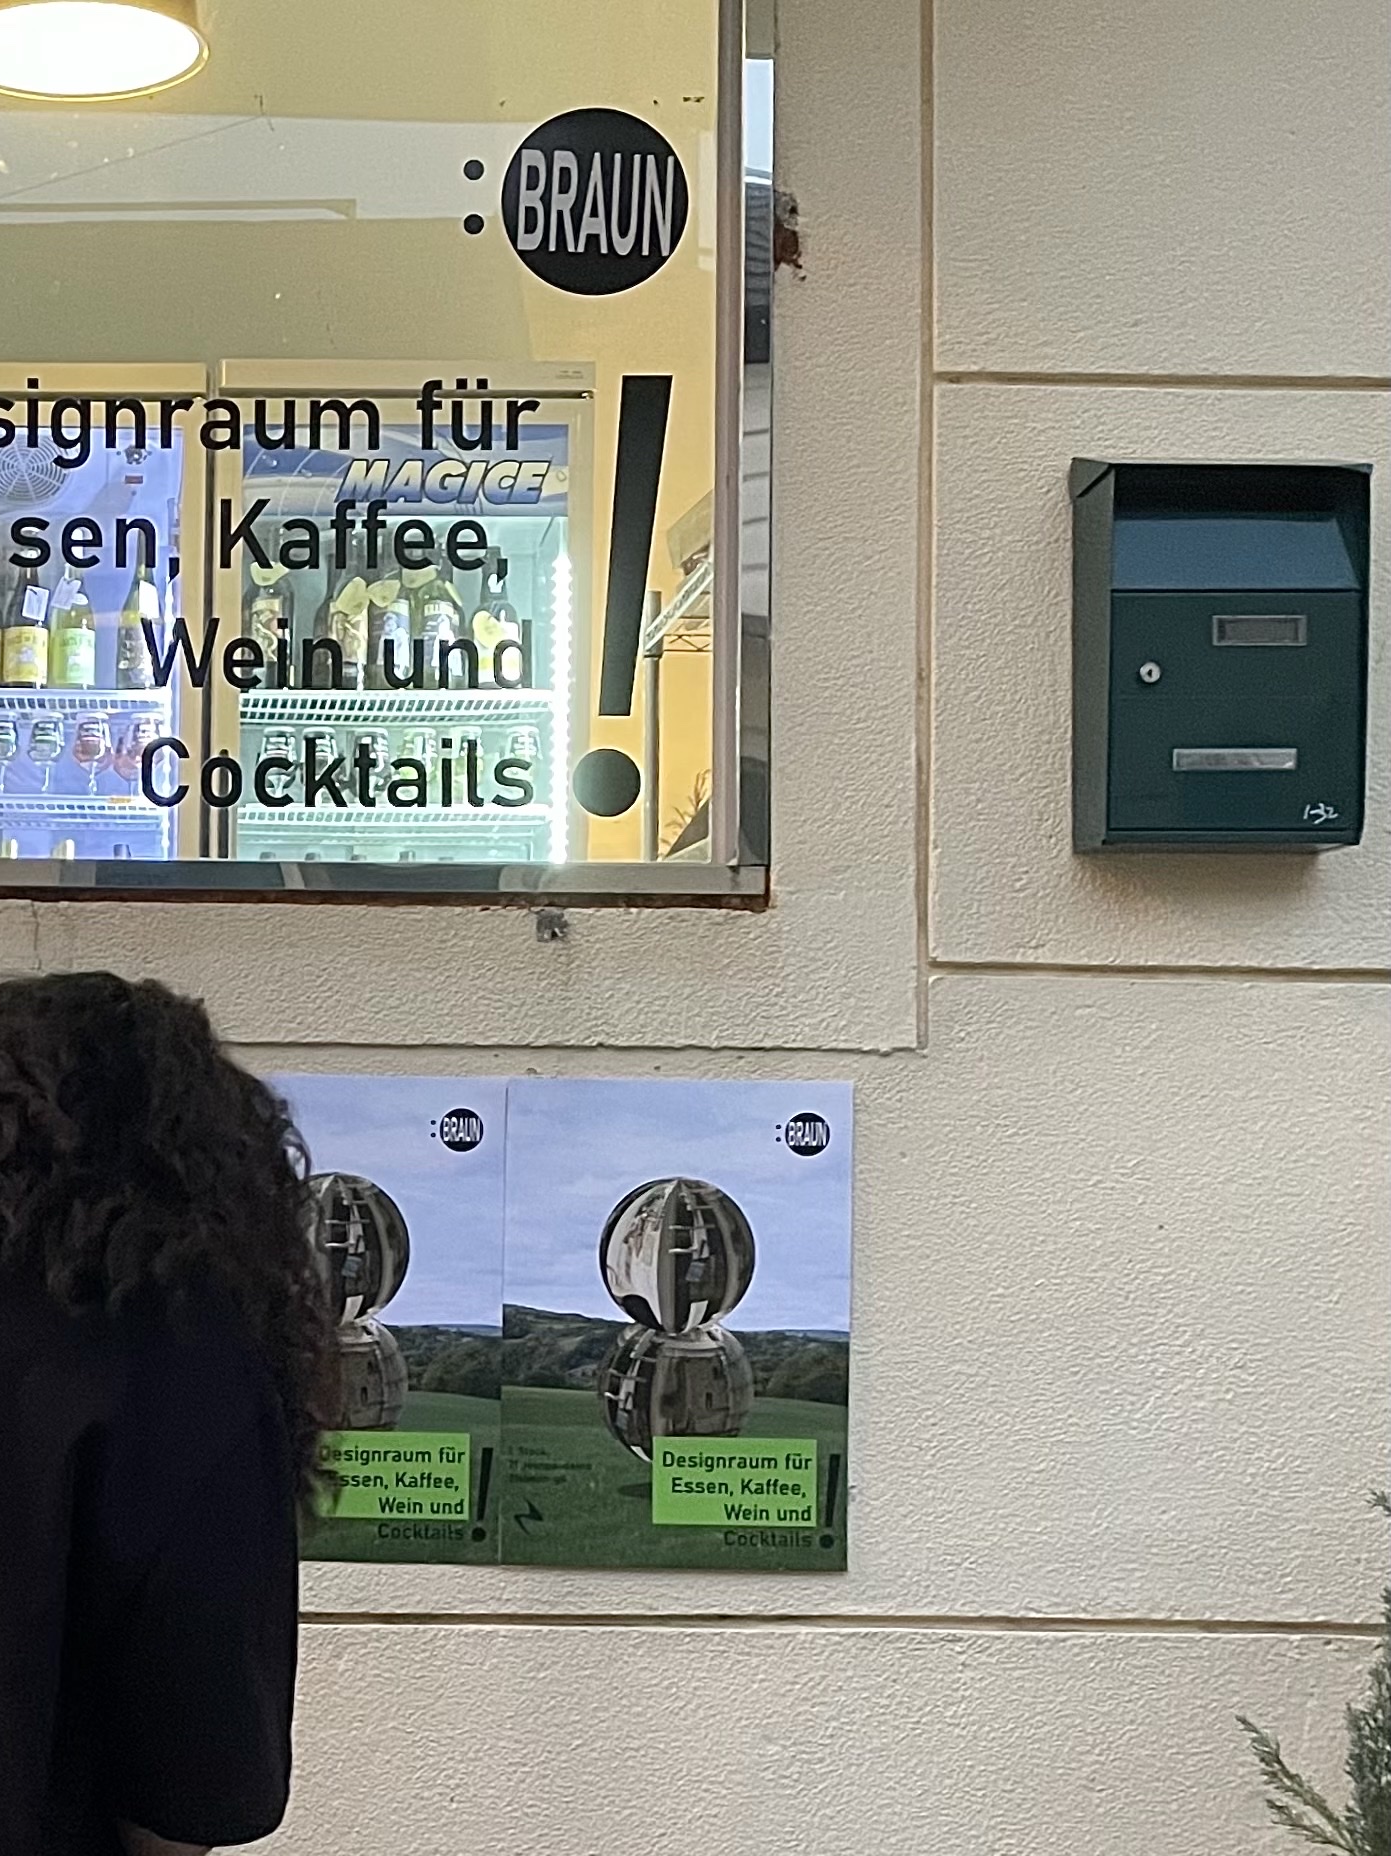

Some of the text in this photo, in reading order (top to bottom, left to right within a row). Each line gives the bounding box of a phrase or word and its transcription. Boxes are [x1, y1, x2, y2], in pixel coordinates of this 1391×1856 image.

[517, 148, 674, 257] BRAUN
[416, 378, 540, 451] für
[335, 458, 552, 505] MAGICE
[218, 498, 509, 585] Kaffee,
[140, 617, 533, 691] Wein und
[140, 736, 534, 809] Cocktails
[443, 1117, 480, 1142] BRAUN
[789, 1122, 827, 1146] BRAUN
[319, 1445, 466, 1466] Designraum für
[662, 1450, 813, 1473] Designraum für
[395, 1471, 460, 1493] Kaffee,
[671, 1476, 807, 1499] Essen, Kaffee,
[378, 1496, 465, 1515] Wein und
[724, 1503, 812, 1522] Wein und
[377, 1522, 465, 1541] Cocktails
[723, 1530, 813, 1548] Cocktails
